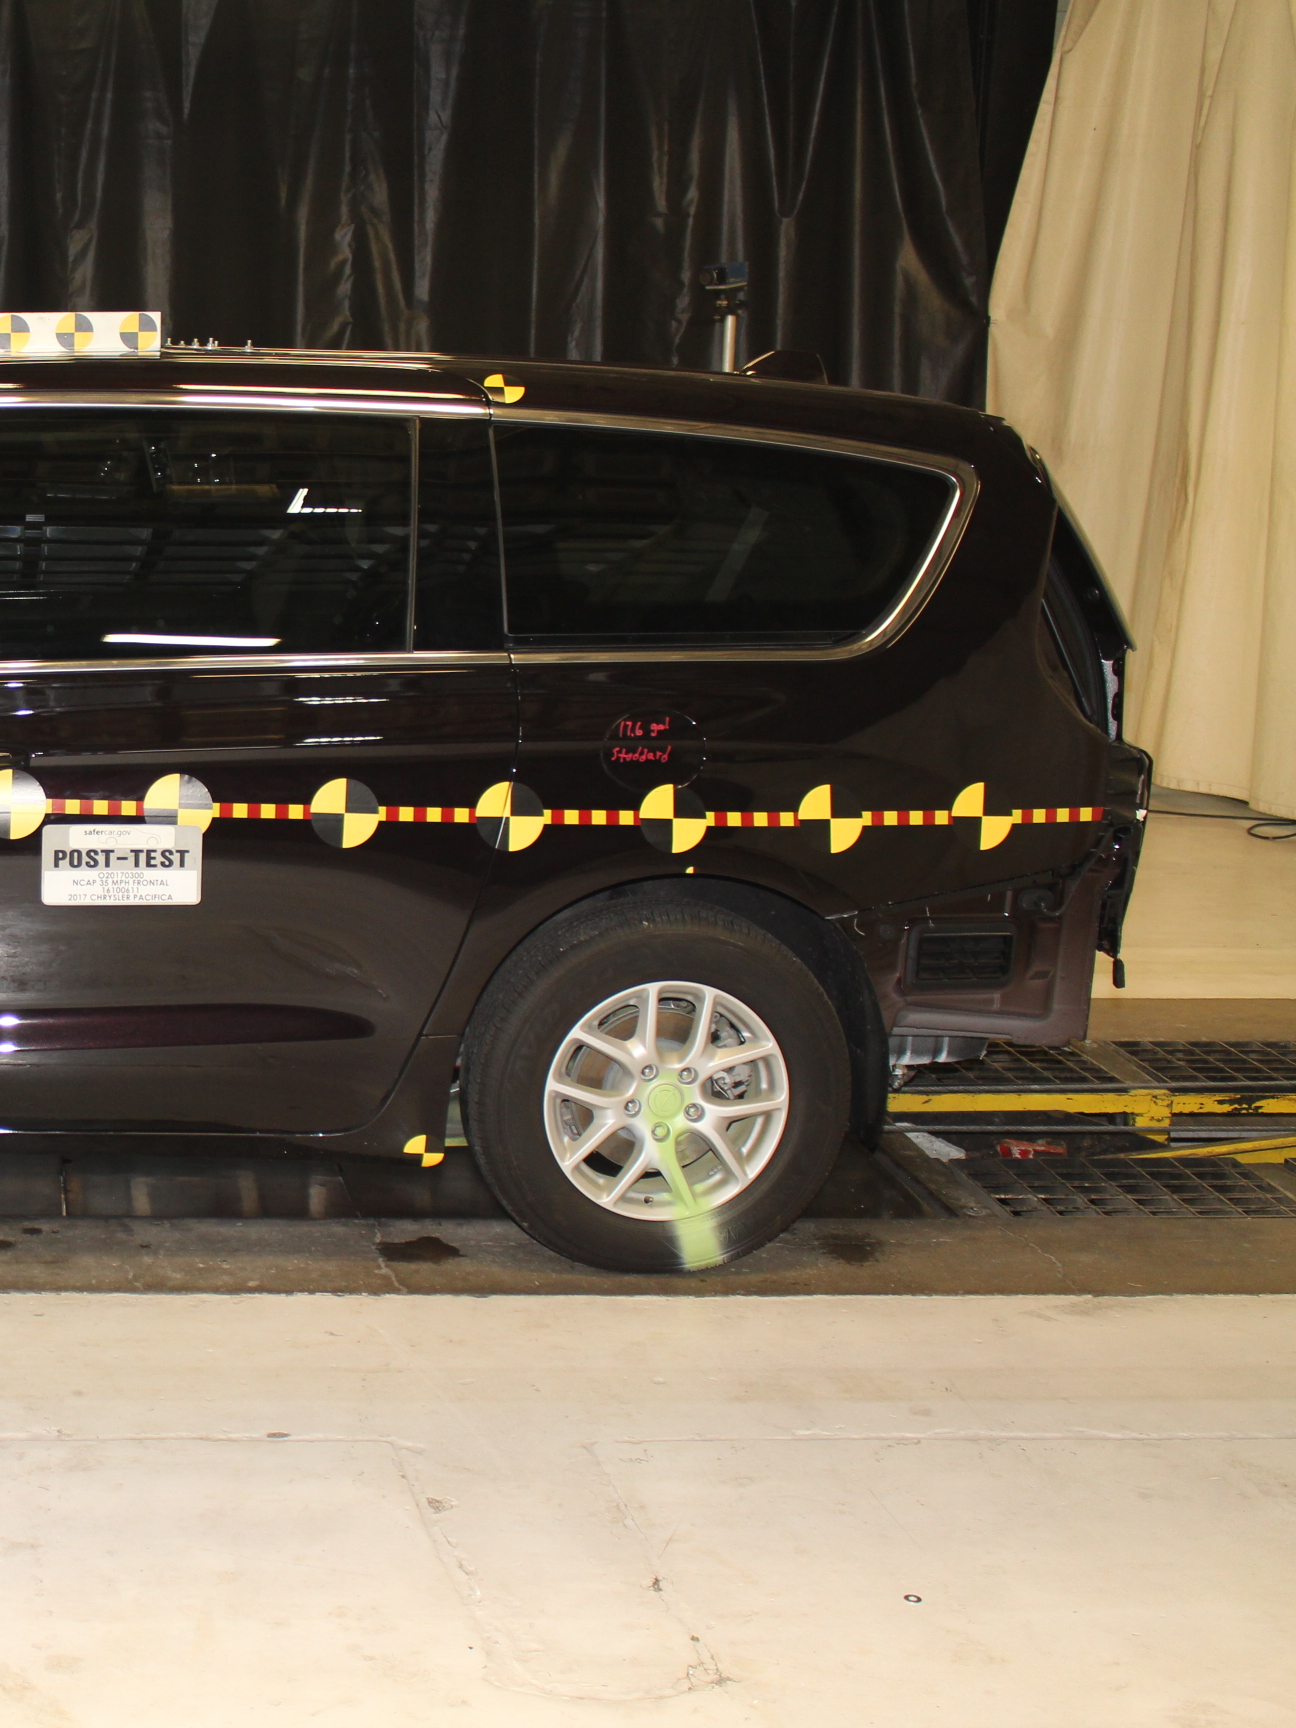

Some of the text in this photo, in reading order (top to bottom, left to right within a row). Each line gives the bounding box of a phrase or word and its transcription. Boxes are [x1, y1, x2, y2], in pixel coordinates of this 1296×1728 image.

[83, 828, 132, 838] safercar.gov
[53, 849, 190, 869] POST-TEST
[72, 879, 169, 887] NCAP 35 MPH FRONTAL
[101, 886, 140, 894] 16100611
[68, 893, 174, 902] 2017 CHRYSLER PACIFICA
